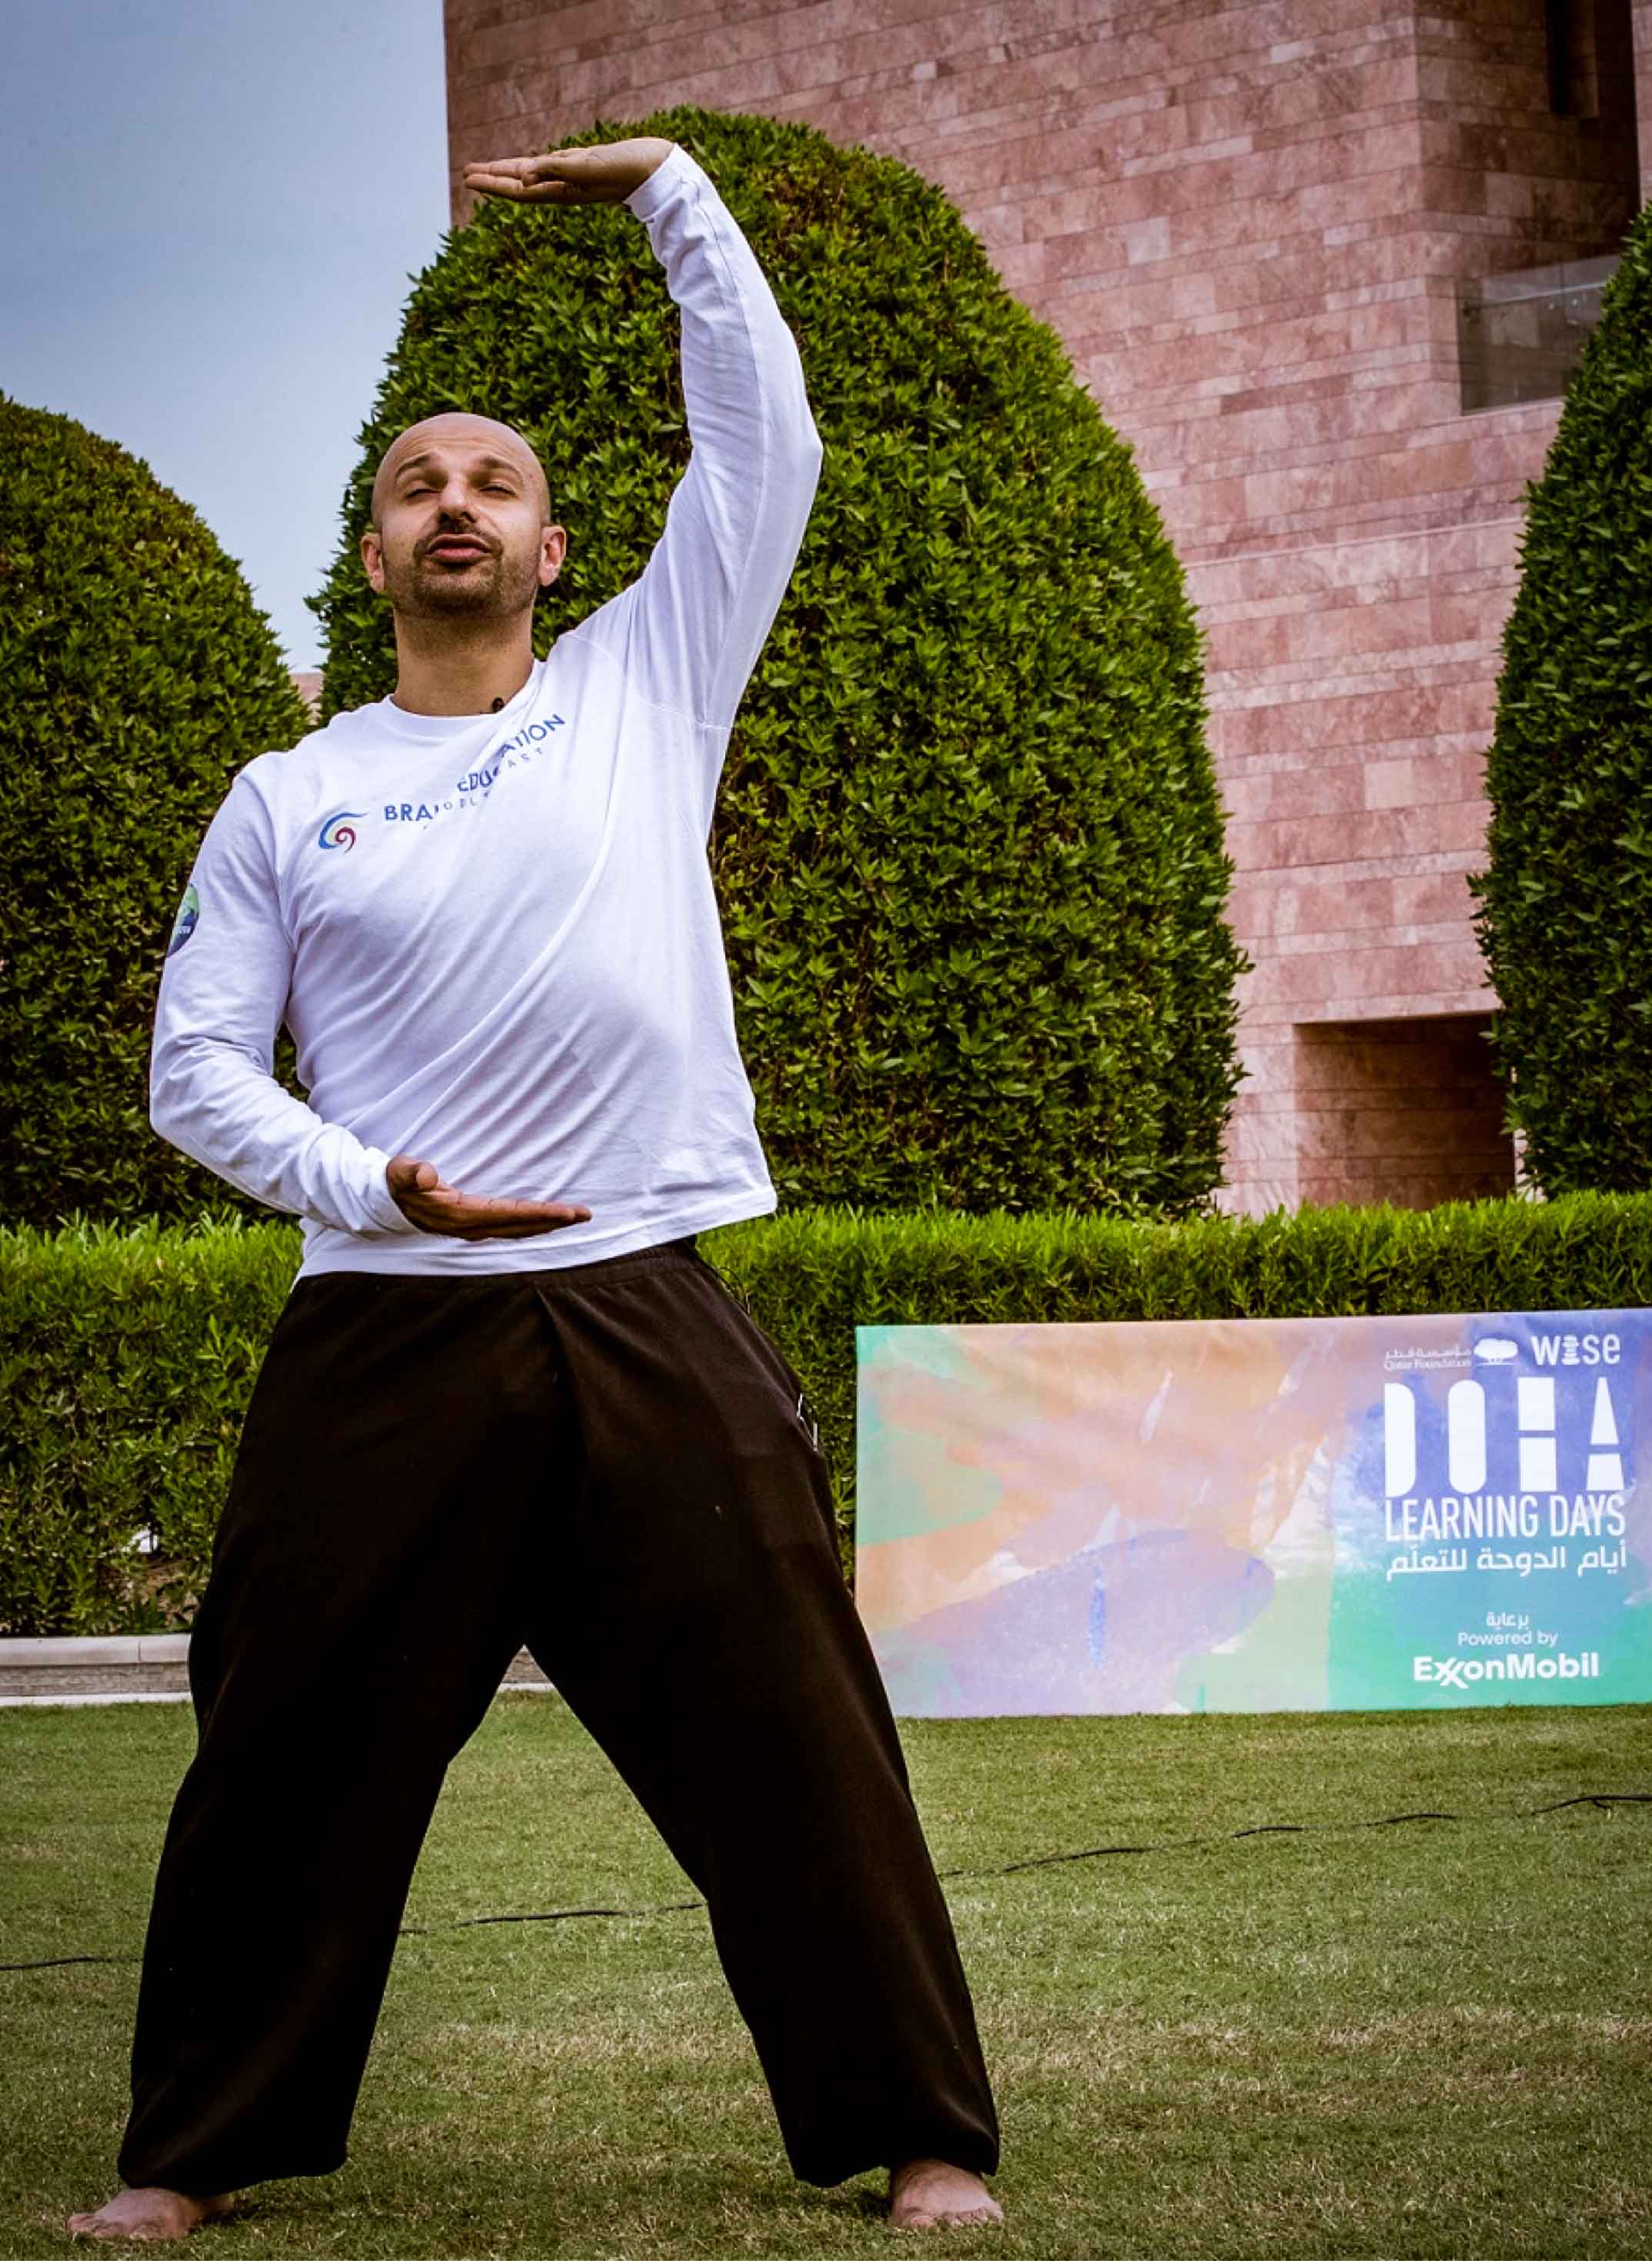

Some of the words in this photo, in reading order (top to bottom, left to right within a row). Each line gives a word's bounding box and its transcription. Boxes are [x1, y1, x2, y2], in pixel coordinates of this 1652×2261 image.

[383, 801, 439, 822] BRA
[1384, 1377, 1625, 1499] DOHA
[1384, 1496, 1539, 1542] LEARNING
[1549, 1493, 1627, 1537] DAYS
[1476, 1545, 1567, 1577] الدوحة
[1577, 1539, 1627, 1577] أيام
[1457, 1629, 1533, 1647] Powered
[1537, 1629, 1560, 1648] by
[1413, 1651, 1600, 1690] ExxonMobil
